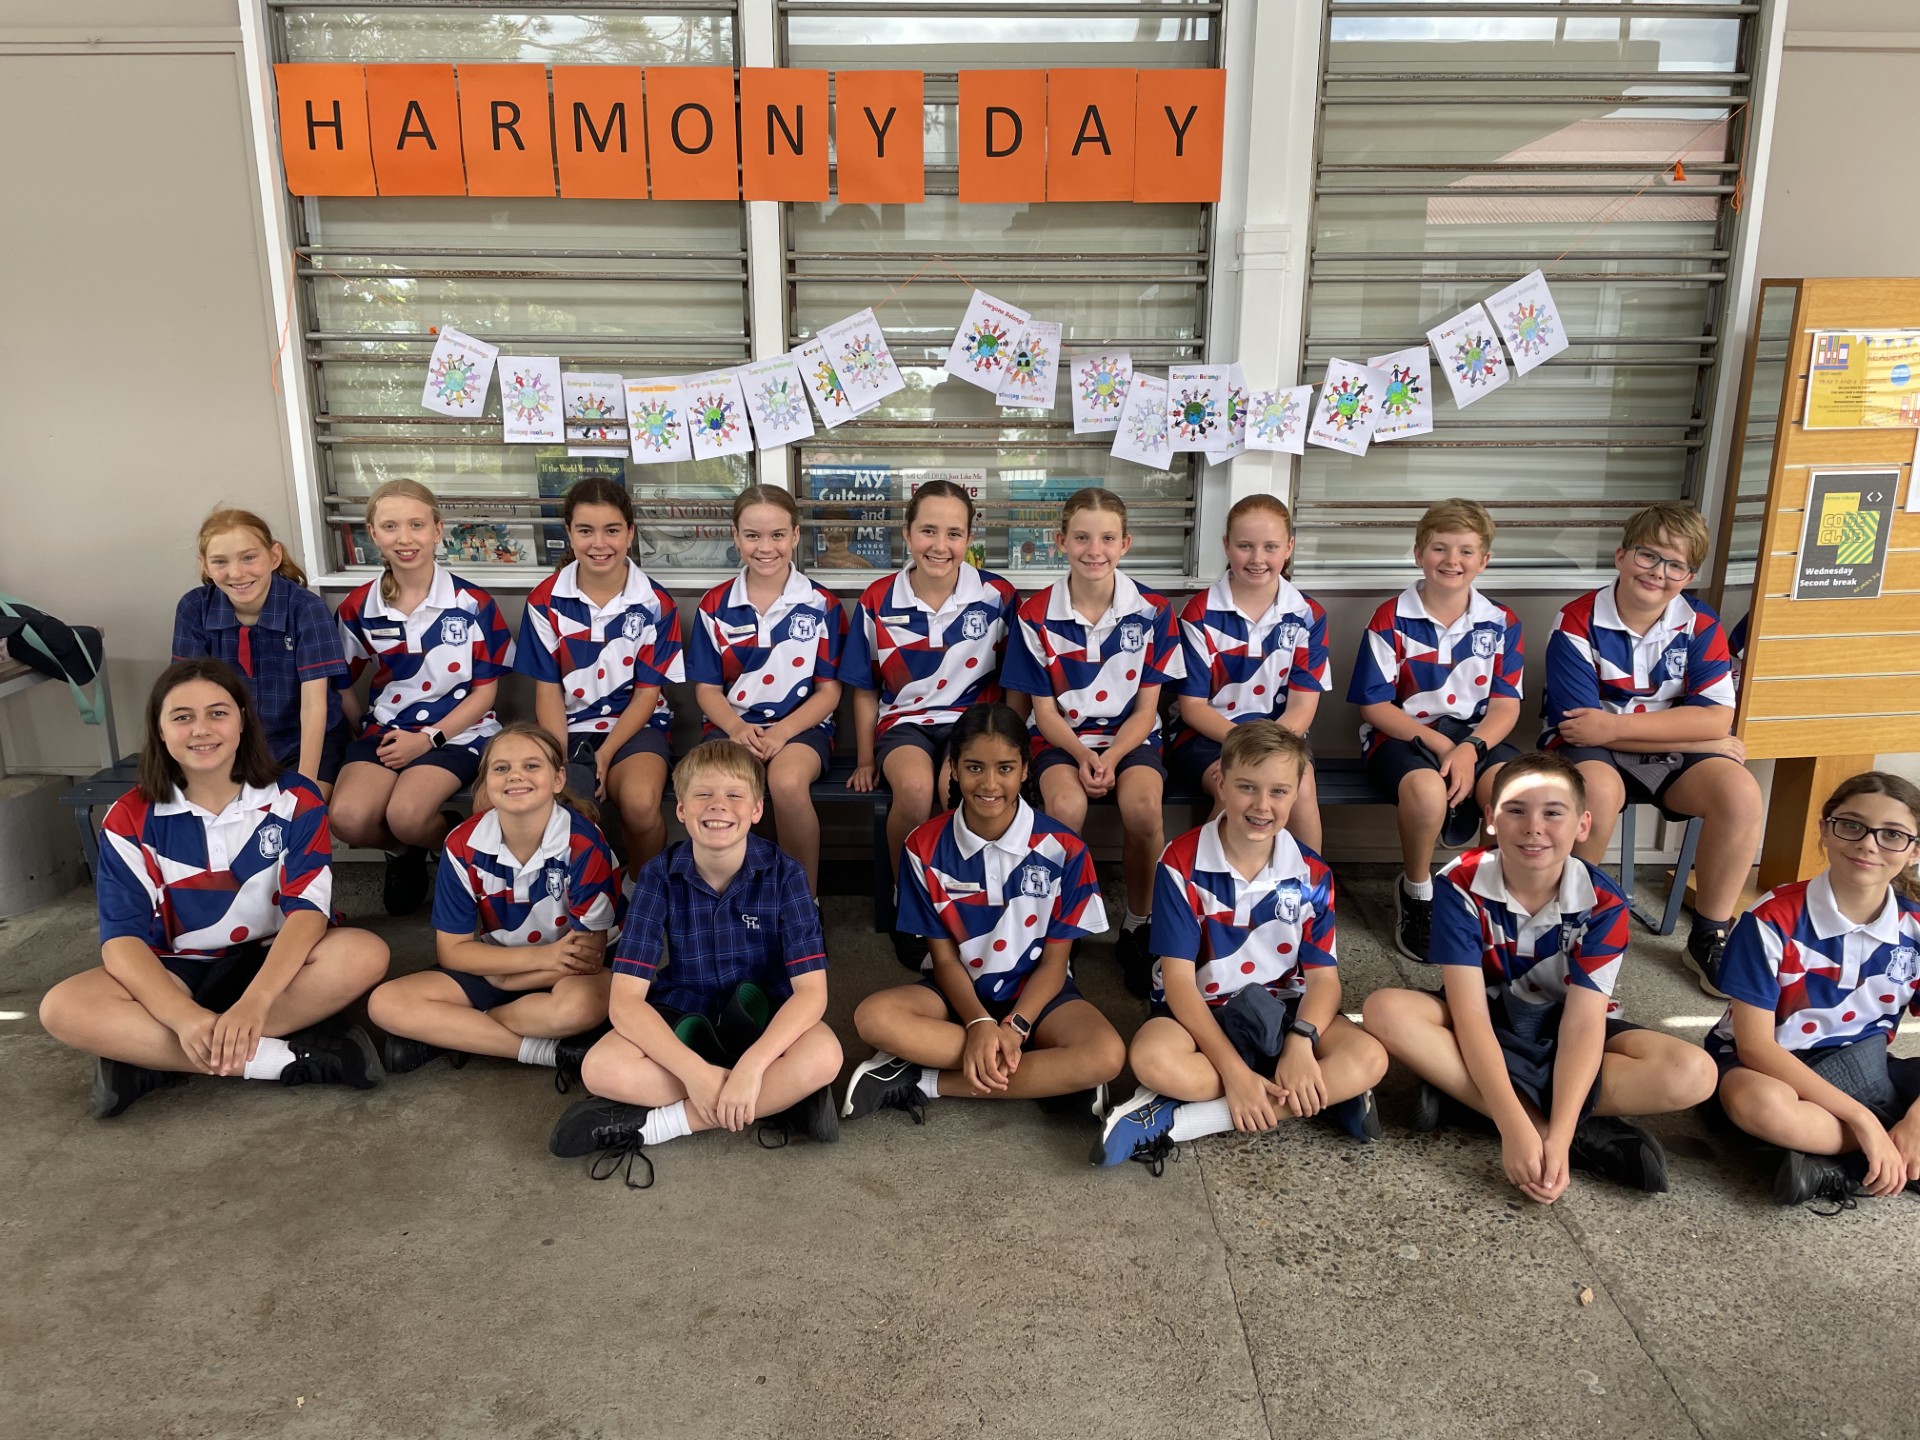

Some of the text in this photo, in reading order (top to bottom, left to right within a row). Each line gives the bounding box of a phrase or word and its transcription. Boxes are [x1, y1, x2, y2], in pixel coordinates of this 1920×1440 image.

[305, 100, 1198, 158] HARMONY DAY
[1173, 373, 1198, 381] Everyone
[541, 463, 548, 472] If
[549, 464, 559, 472] the
[559, 464, 578, 472] World
[578, 464, 594, 472] Were
[599, 463, 620, 475] Village
[861, 508, 885, 520] and
[857, 527, 885, 541] ME
[1805, 567, 1854, 576] Wednesday
[1800, 577, 1858, 587] Second break
